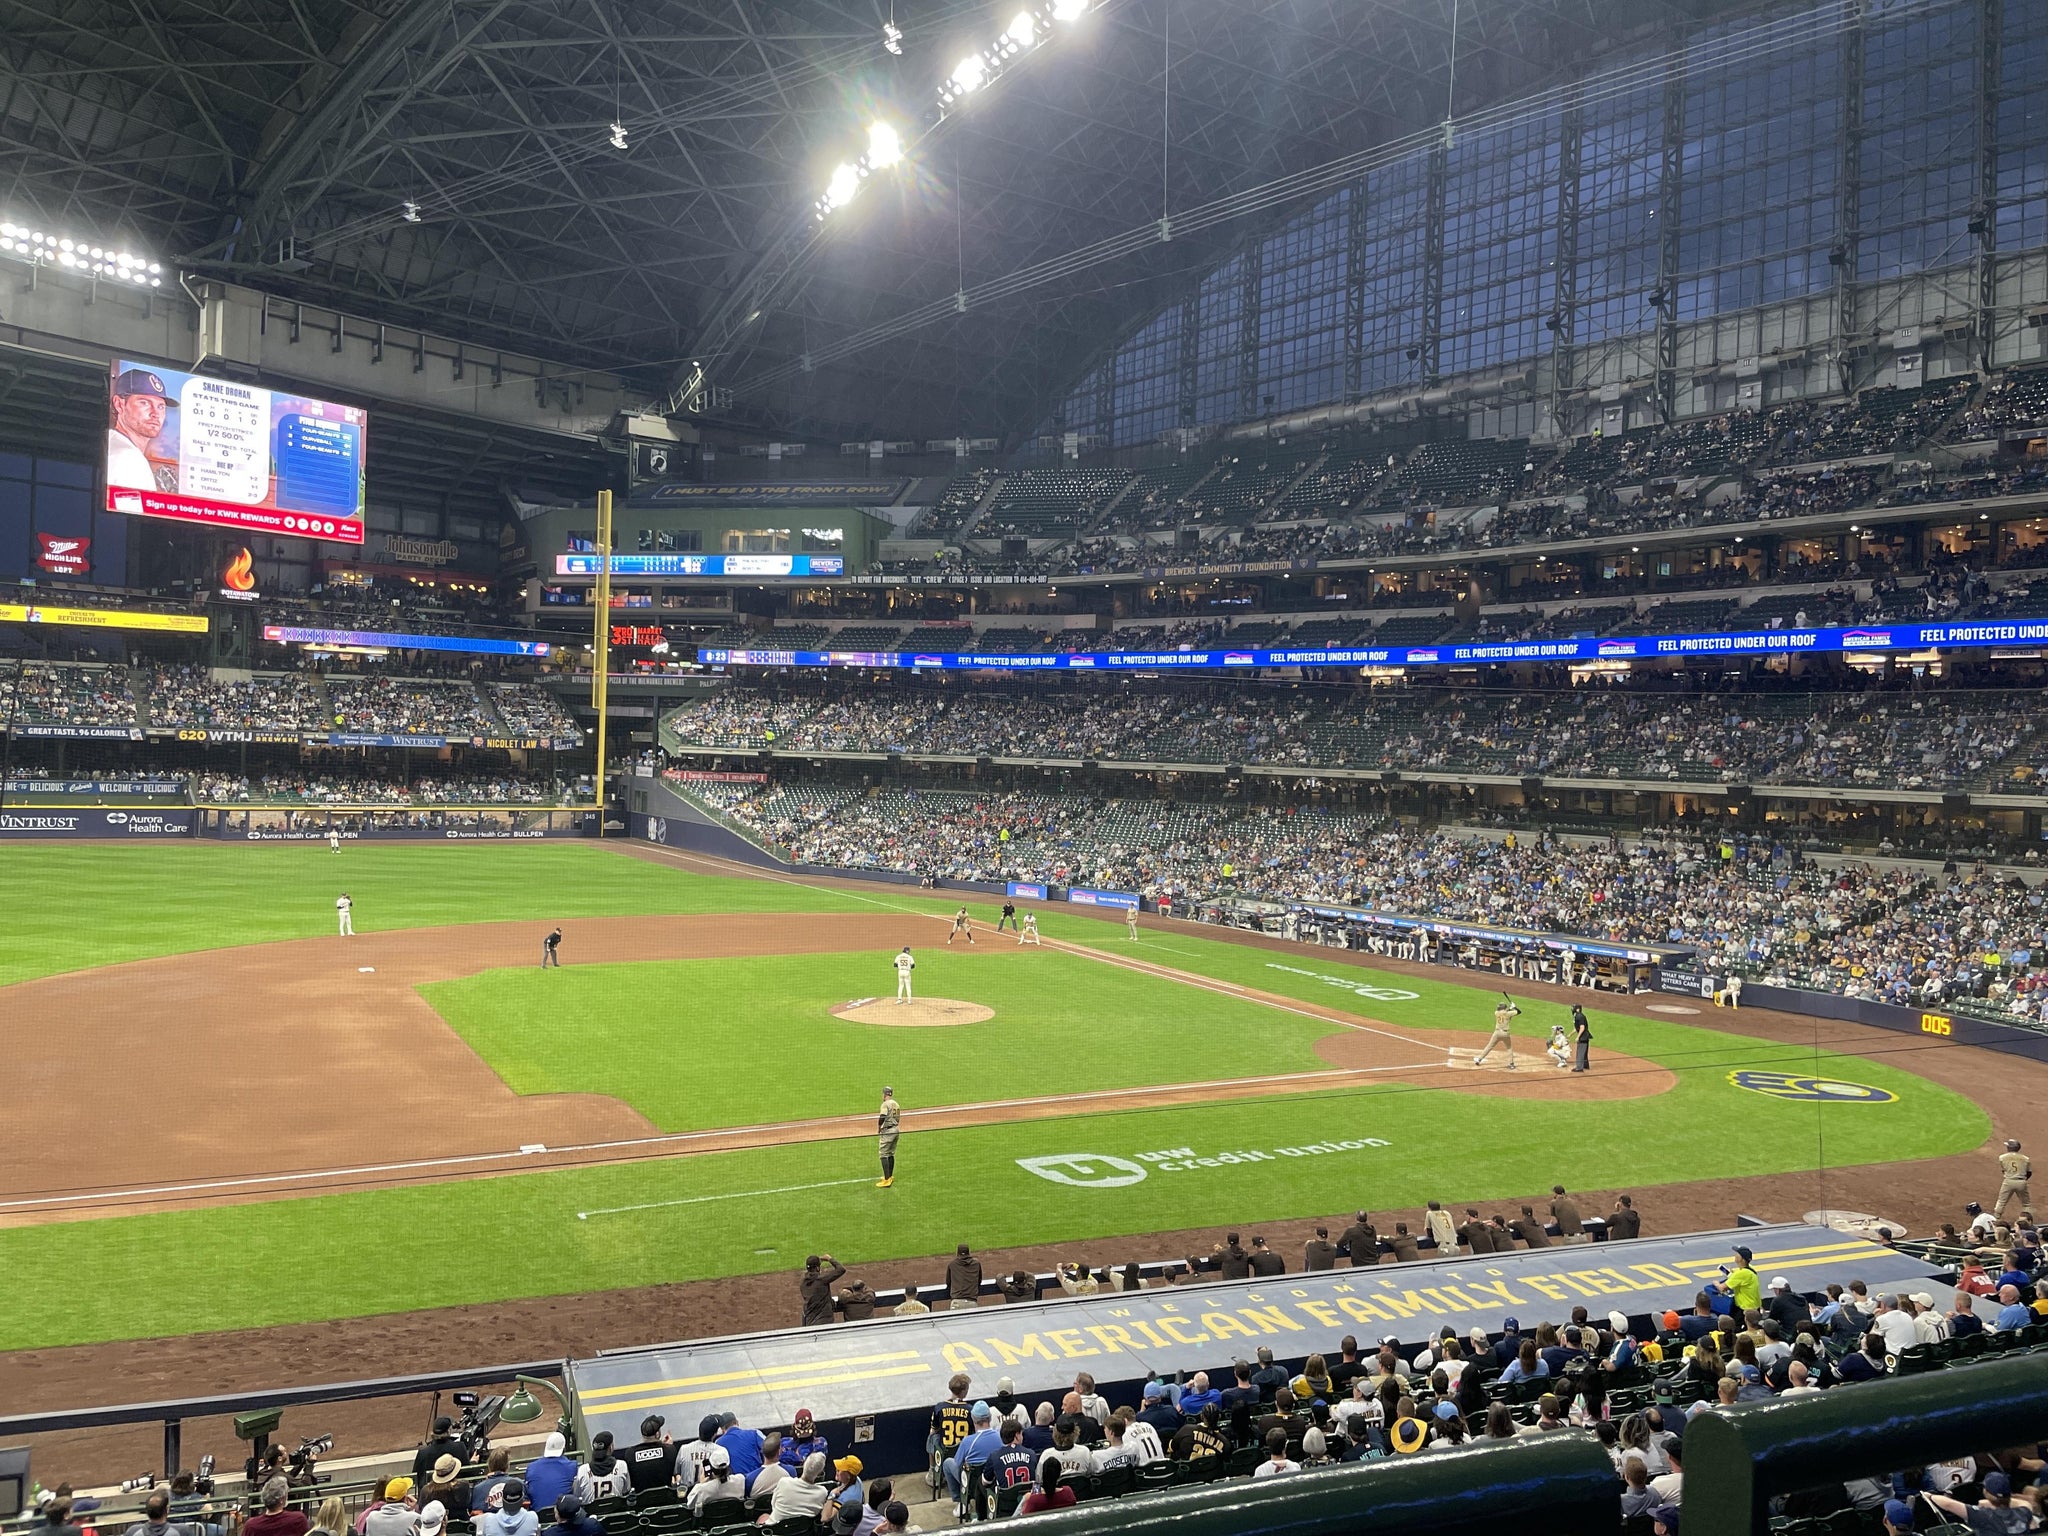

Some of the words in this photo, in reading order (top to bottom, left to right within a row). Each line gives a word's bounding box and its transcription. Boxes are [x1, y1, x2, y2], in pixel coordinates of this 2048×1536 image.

[791, 486, 843, 494] FRONT
[146, 499, 165, 510] Sign
[167, 504, 178, 512] up
[179, 504, 202, 516] today
[204, 507, 216, 516] for
[217, 509, 239, 519] KWIK
[240, 511, 281, 525] REWARDS
[49, 541, 80, 554] Miller
[385, 535, 458, 559] Johnsonville
[45, 553, 65, 561] HIGH
[65, 555, 83, 563] LIFE
[1164, 567, 1196, 577] BREWERS
[1198, 565, 1242, 574] COMMUNITY
[1245, 561, 1292, 572] FOUNDATION
[57, 615, 107, 624] REFRESHMENT
[1920, 629, 1946, 642] FEEL
[1948, 627, 2015, 641] PROTECTED
[1658, 639, 1678, 651] FEEL
[1680, 638, 1731, 650] PROTECTED
[1734, 637, 1766, 649] UNDER
[1768, 635, 1789, 647] OUR
[1790, 634, 1817, 646] ROOF
[706, 652, 727, 661] 8:23
[1270, 653, 1285, 662] FEEL
[1286, 652, 1326, 662] PROTECTED
[1327, 651, 1352, 661] UNDER
[1353, 651, 1369, 661] OUR
[1369, 650, 1389, 660] ROOF
[1455, 648, 1472, 658] FEEL
[1472, 647, 1513, 658] PROTECTED
[1513, 646, 1539, 657] UNDER
[1540, 645, 1557, 656] OUR
[1557, 644, 1579, 655] ROOF
[973, 657, 1009, 665] PROTECTED
[1010, 657, 1029, 665] UNDER
[1030, 657, 1041, 665] OUR
[1041, 657, 1056, 665] ROOF
[1108, 656, 1122, 665] FEEL
[1122, 655, 1156, 664] PROTECTED
[1157, 655, 1178, 664] UNDER
[1178, 654, 1191, 663] OUR
[1191, 654, 1208, 663] ROOF
[27, 727, 53, 735] GREAT
[53, 728, 79, 736] TASTE.
[79, 728, 90, 736] 96
[90, 729, 128, 737] CALORIES.
[179, 730, 207, 741] 620
[209, 730, 253, 741] WTMJ
[391, 736, 441, 746] WINTRUST
[486, 739, 518, 748] NICOLET
[521, 739, 537, 748] LAW
[30, 783, 65, 792] DELICIOUS
[99, 783, 132, 793] WELCOME
[143, 784, 176, 793] DELICIOUS
[129, 815, 163, 823] Aurora
[128, 824, 163, 832] Health
[164, 824, 188, 832] Care
[1921, 1013, 1951, 1036] 005
[1158, 1149, 1276, 1171] credit
[1272, 1137, 1393, 1157] union
[940, 1304, 1306, 1372] AMERICAN
[1293, 1280, 1528, 1328] FAMILY
[1517, 1263, 1692, 1301] FIELD
[942, 1407, 969, 1419] BURNES
[941, 1420, 969, 1447] 39
[1141, 1436, 1158, 1459] 11
[1000, 1452, 1031, 1465] TURANG
